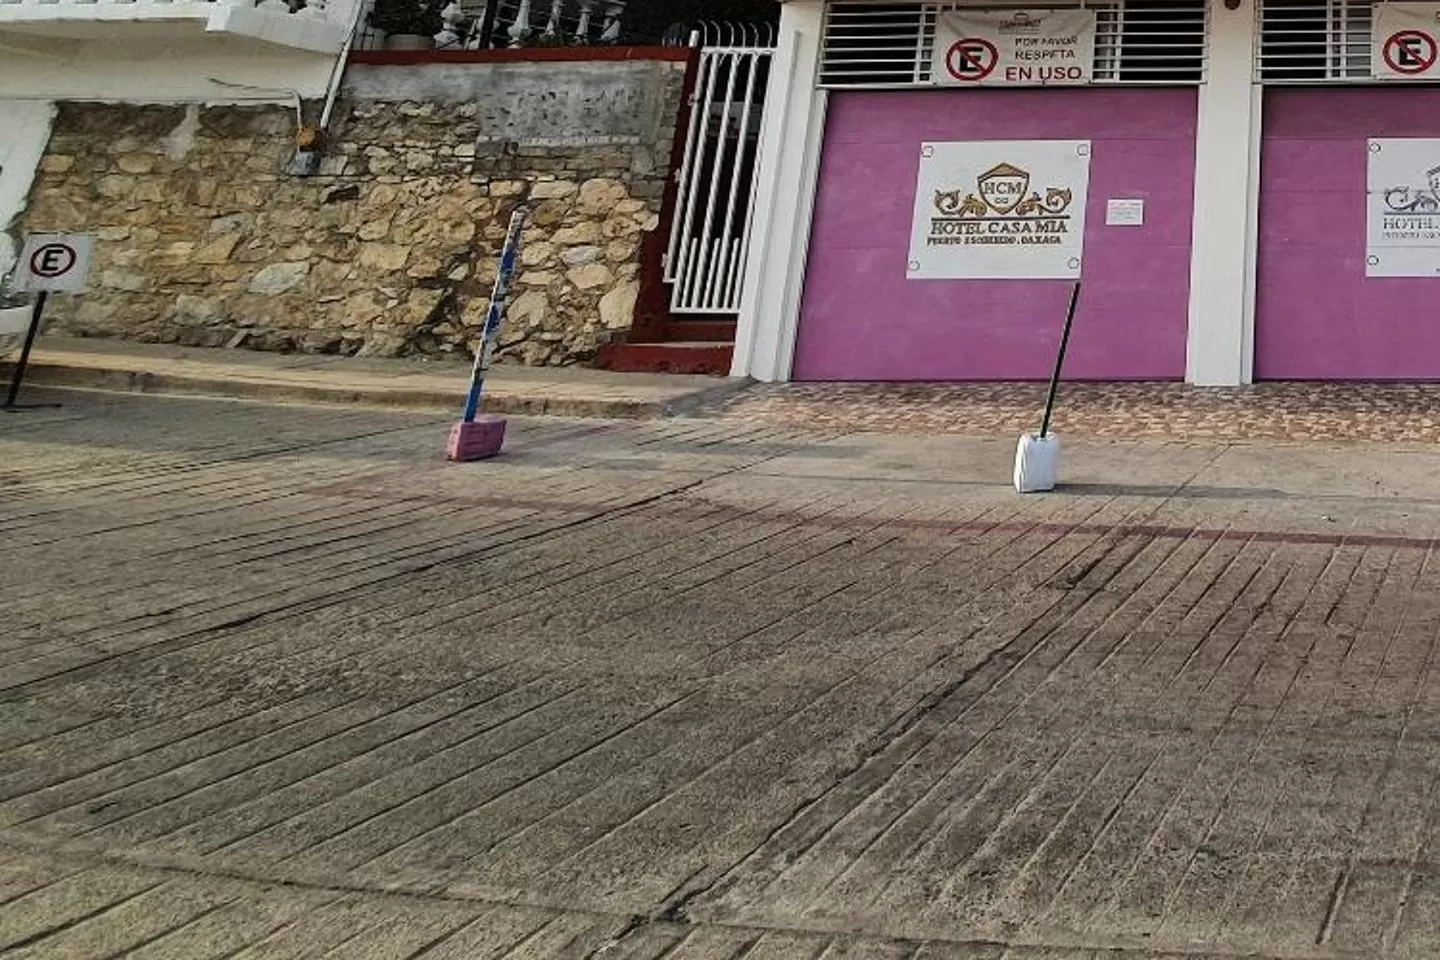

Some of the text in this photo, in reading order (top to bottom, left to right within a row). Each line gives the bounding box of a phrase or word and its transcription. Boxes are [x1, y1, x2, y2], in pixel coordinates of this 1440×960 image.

[1015, 49, 1075, 60] RESPETA
[1005, 66, 1082, 81] EN USO
[984, 182, 1022, 194] HCM
[931, 220, 1068, 235] HOTEL CASA MIA
[1383, 217, 1438, 230] HOTEL
[41, 249, 64, 271] E
